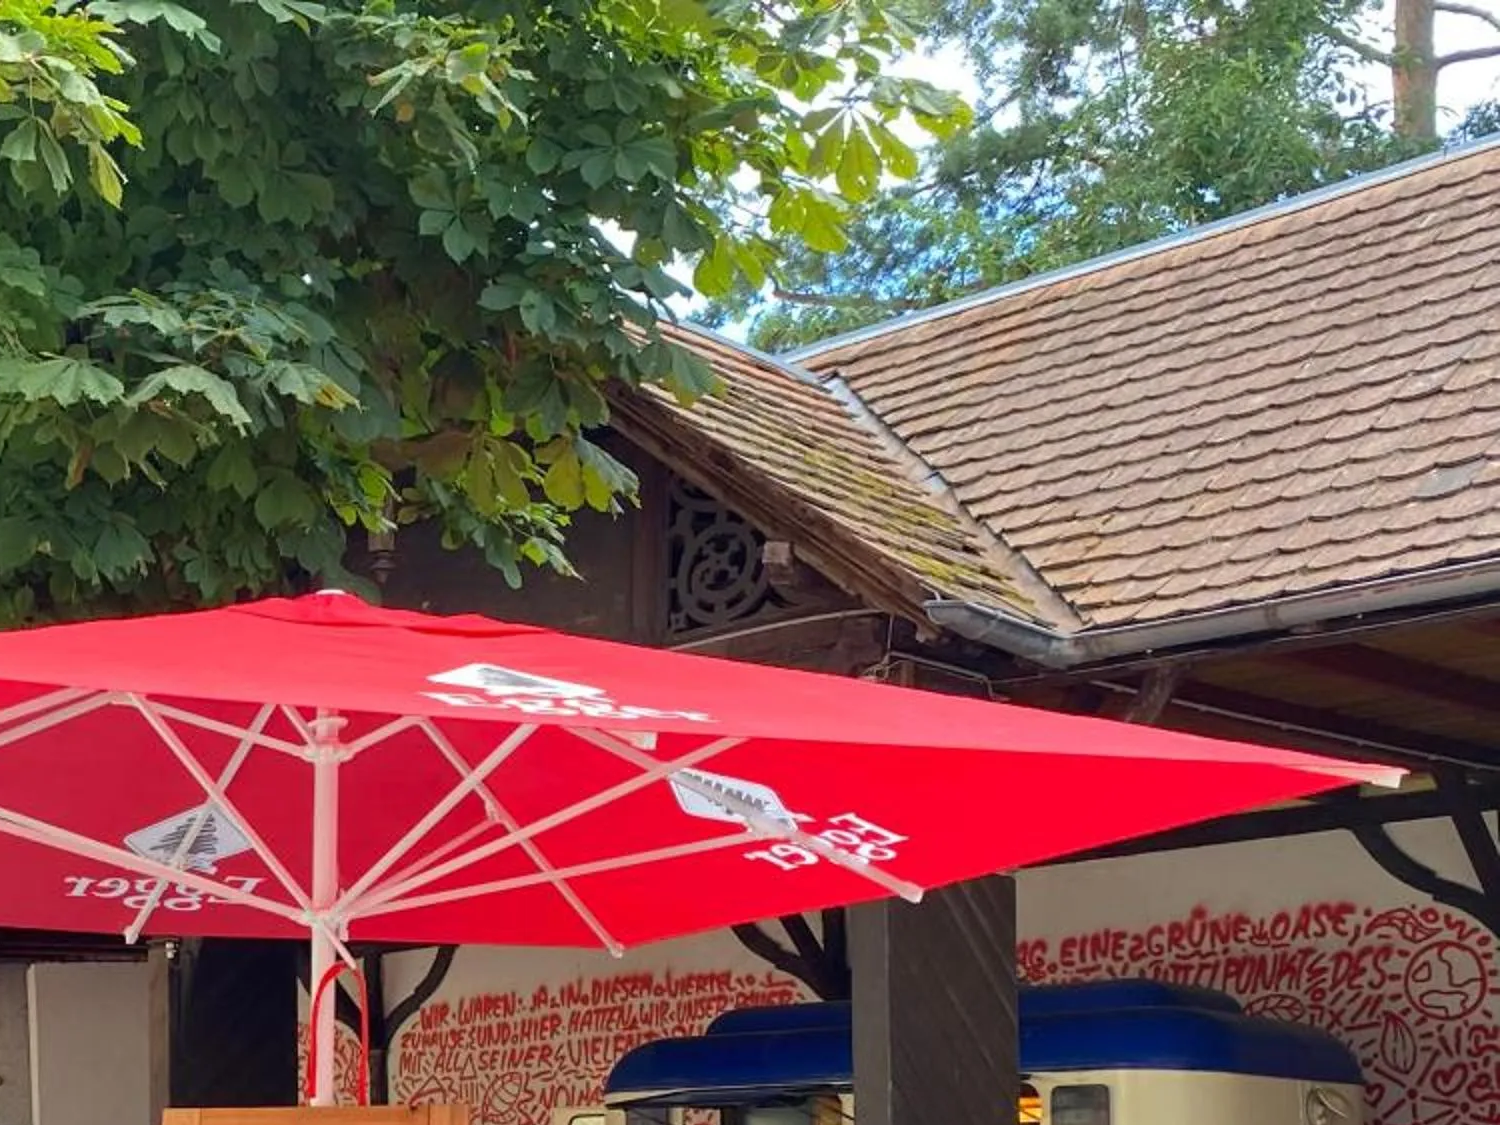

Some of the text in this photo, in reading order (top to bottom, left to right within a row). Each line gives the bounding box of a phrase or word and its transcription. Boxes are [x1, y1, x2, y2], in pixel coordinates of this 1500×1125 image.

[1060, 929, 1127, 967] EINE
[1147, 904, 1251, 957] GRÜNE
[1329, 945, 1393, 990] DES
[420, 1002, 449, 1030] WIR
[477, 1021, 510, 1047] UND
[520, 1012, 562, 1041] HIER
[640, 1001, 669, 1028] WIR
[399, 1051, 425, 1077] MIT
[478, 1044, 553, 1070] SEINER
